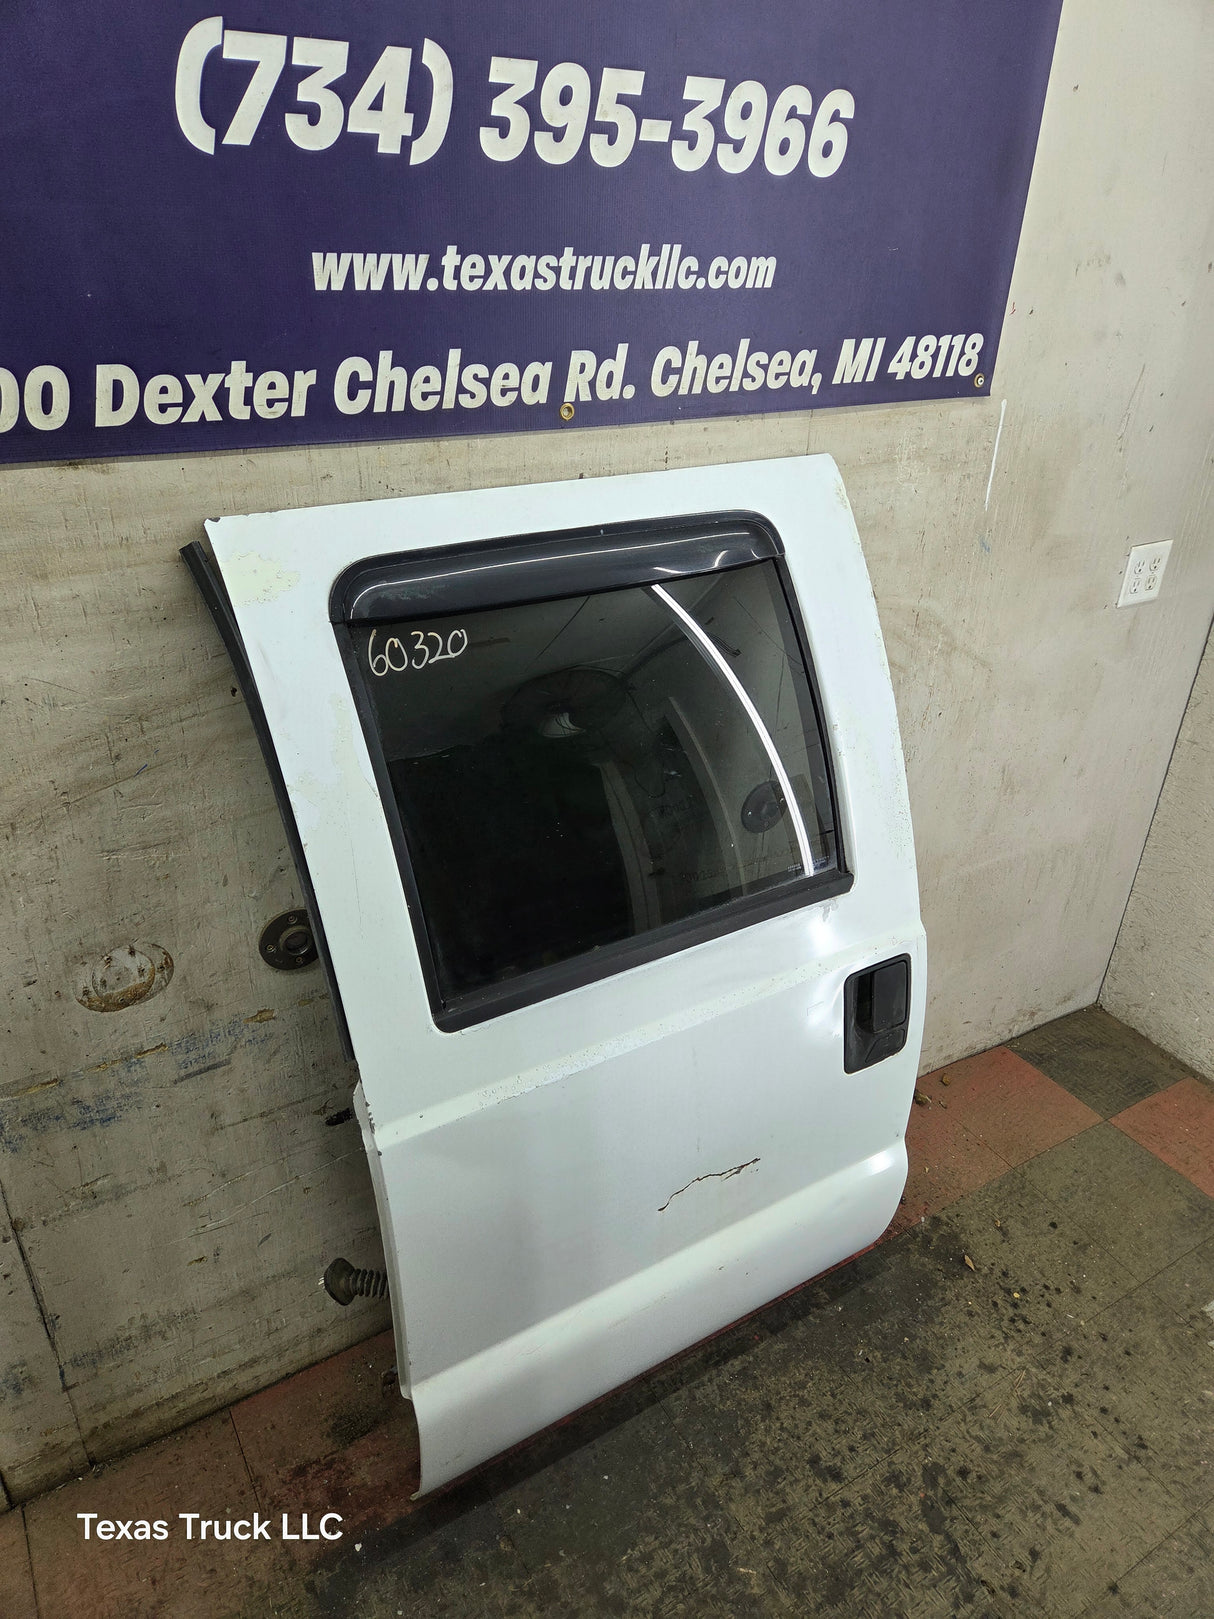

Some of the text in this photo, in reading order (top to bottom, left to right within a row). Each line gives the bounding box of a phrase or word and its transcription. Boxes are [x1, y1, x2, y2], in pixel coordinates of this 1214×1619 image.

[175, 16, 854, 178] (734) 395-3966
[312, 244, 776, 291] www.texastruckllc.com
[95, 361, 316, 427] Dexter
[334, 349, 552, 414] Chelsea
[564, 343, 635, 402] Rd.
[651, 338, 822, 397] Chelsea,
[832, 337, 886, 384] MI
[887, 333, 984, 380] 48118
[367, 628, 468, 676] 60320
